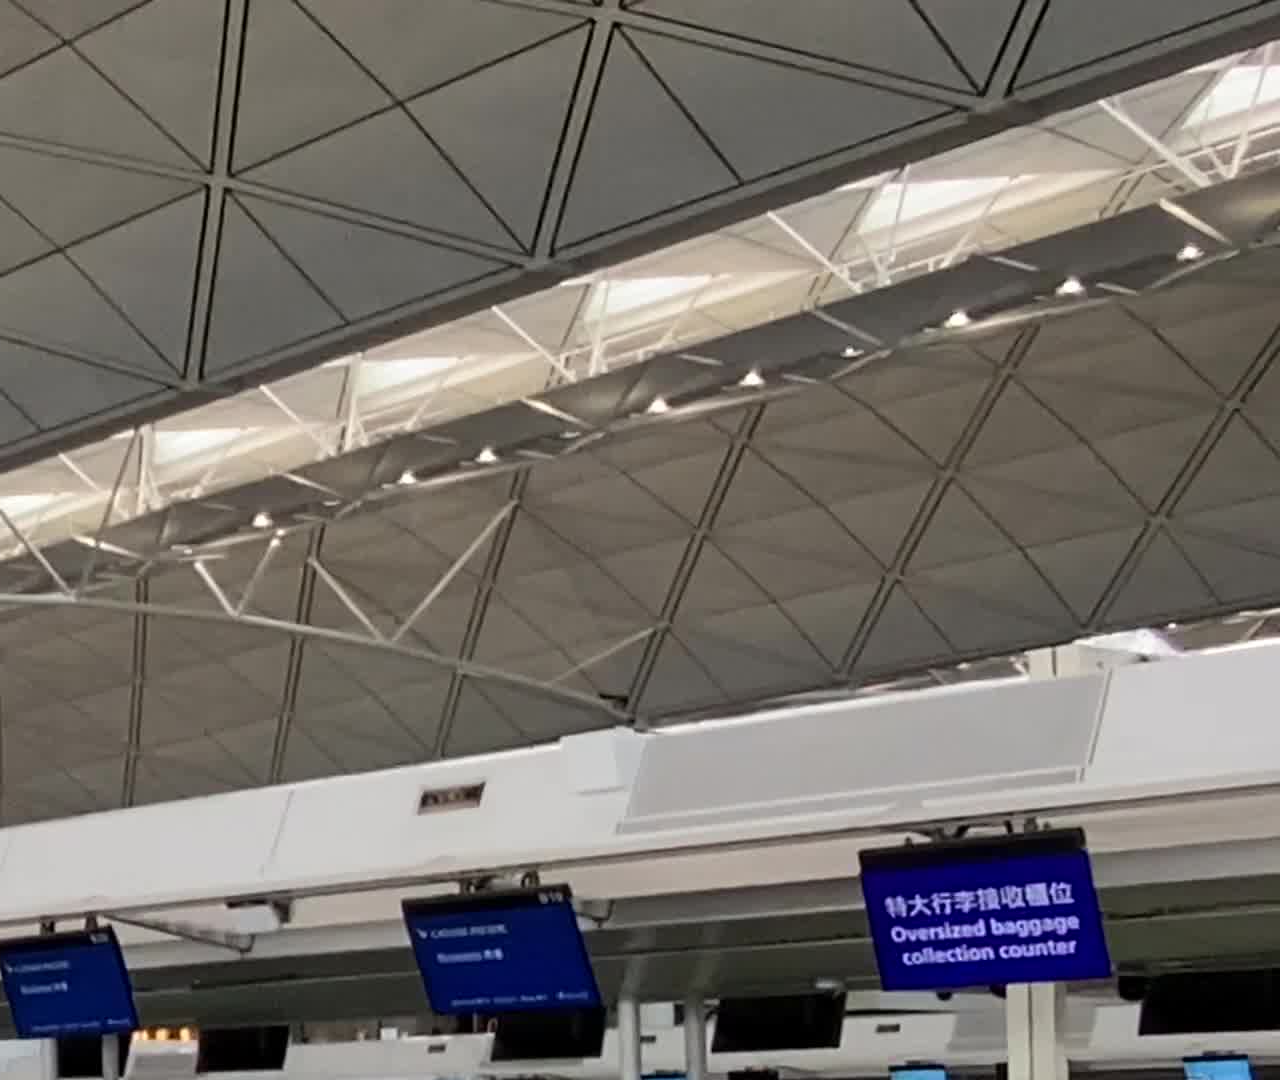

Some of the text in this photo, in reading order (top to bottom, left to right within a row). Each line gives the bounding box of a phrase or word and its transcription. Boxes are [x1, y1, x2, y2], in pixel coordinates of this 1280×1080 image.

[891, 915, 1080, 943] Oversized baggage
[902, 940, 1077, 965] collection counter
